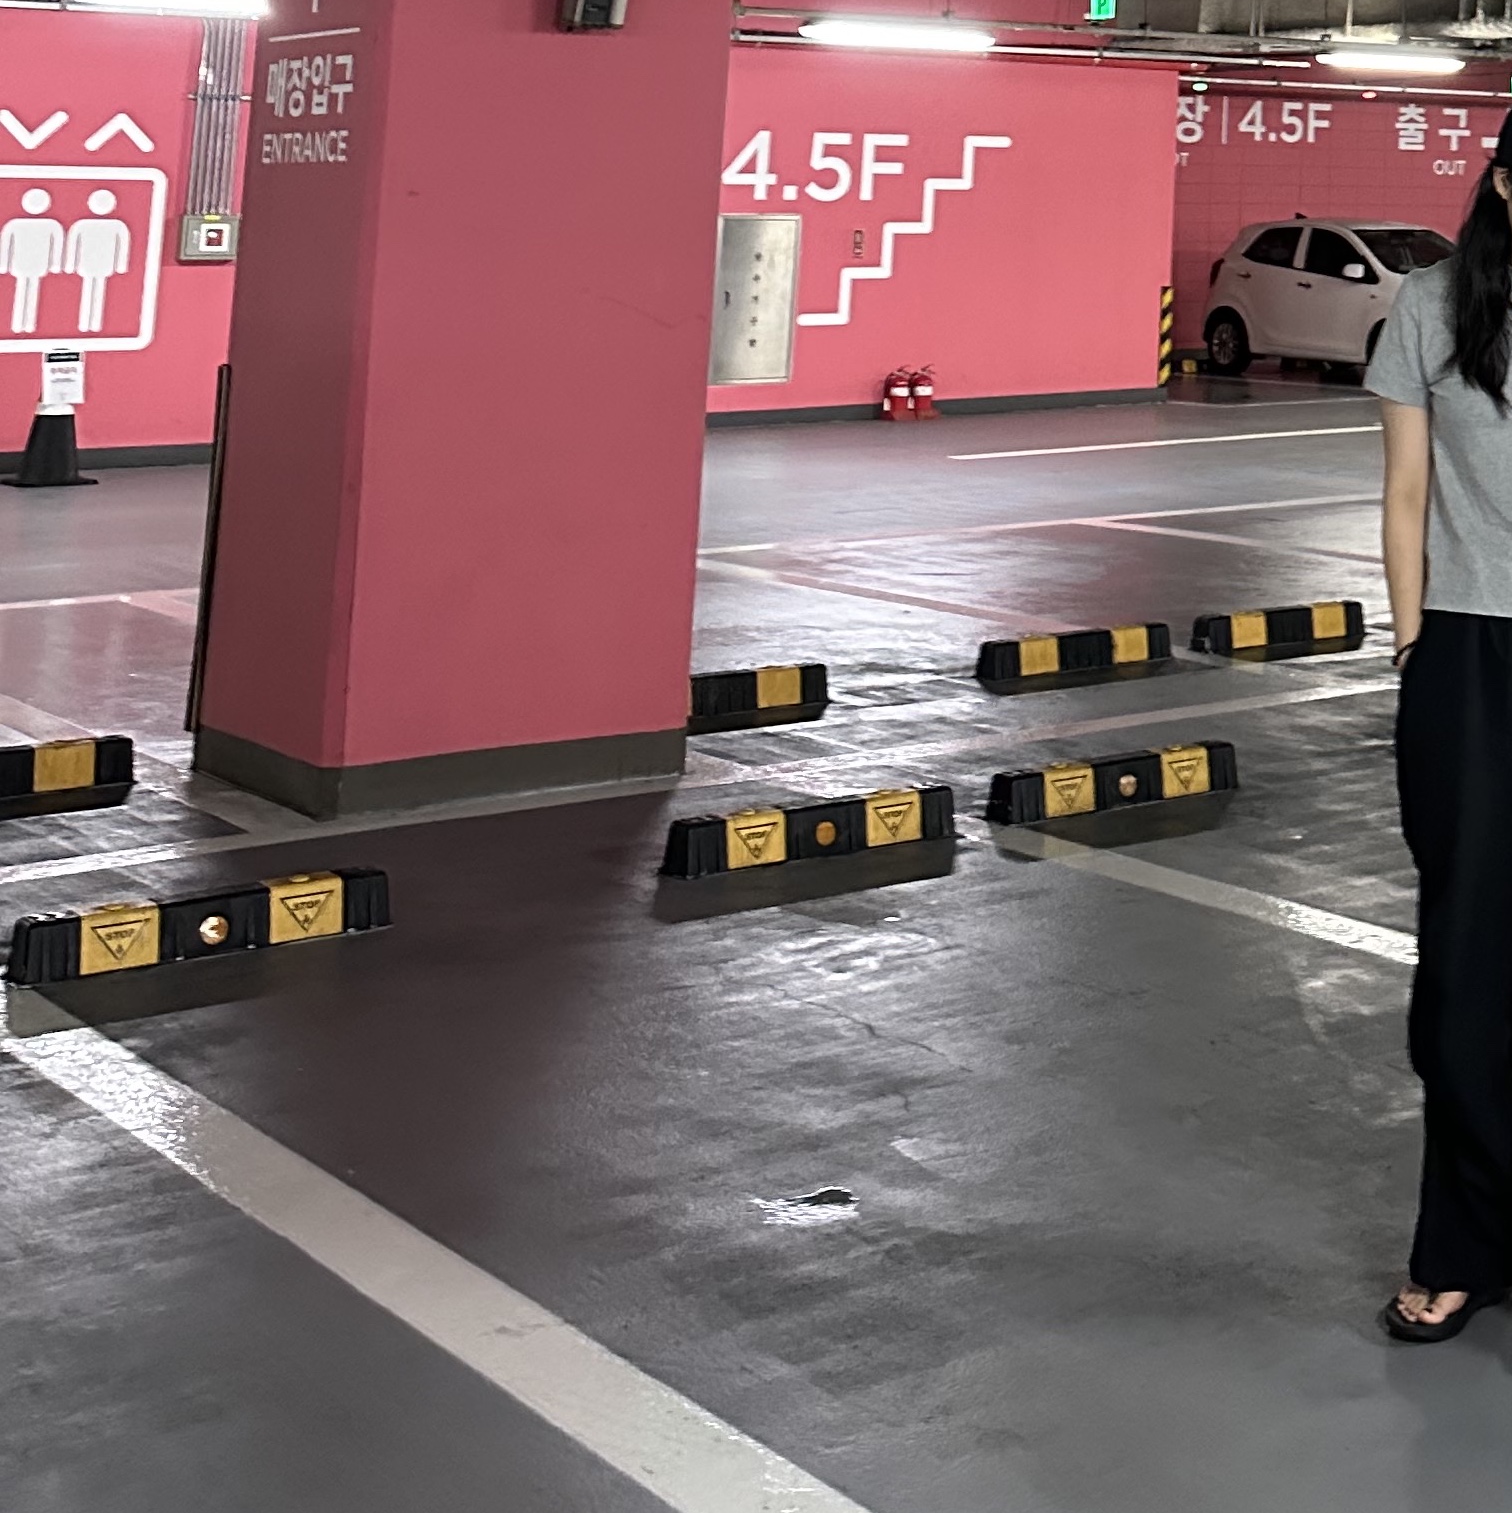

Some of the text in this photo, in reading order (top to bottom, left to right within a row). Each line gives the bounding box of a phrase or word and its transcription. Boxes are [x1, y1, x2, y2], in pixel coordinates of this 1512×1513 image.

[266, 54, 354, 117] 매장입구
[1237, 99, 1333, 144] 4.5F
[262, 130, 349, 164] ENTRANCE
[720, 129, 910, 202] 4.5F
[1432, 159, 1467, 176] OUT
[292, 899, 321, 911] STOP
[104, 928, 136, 941] STOP
